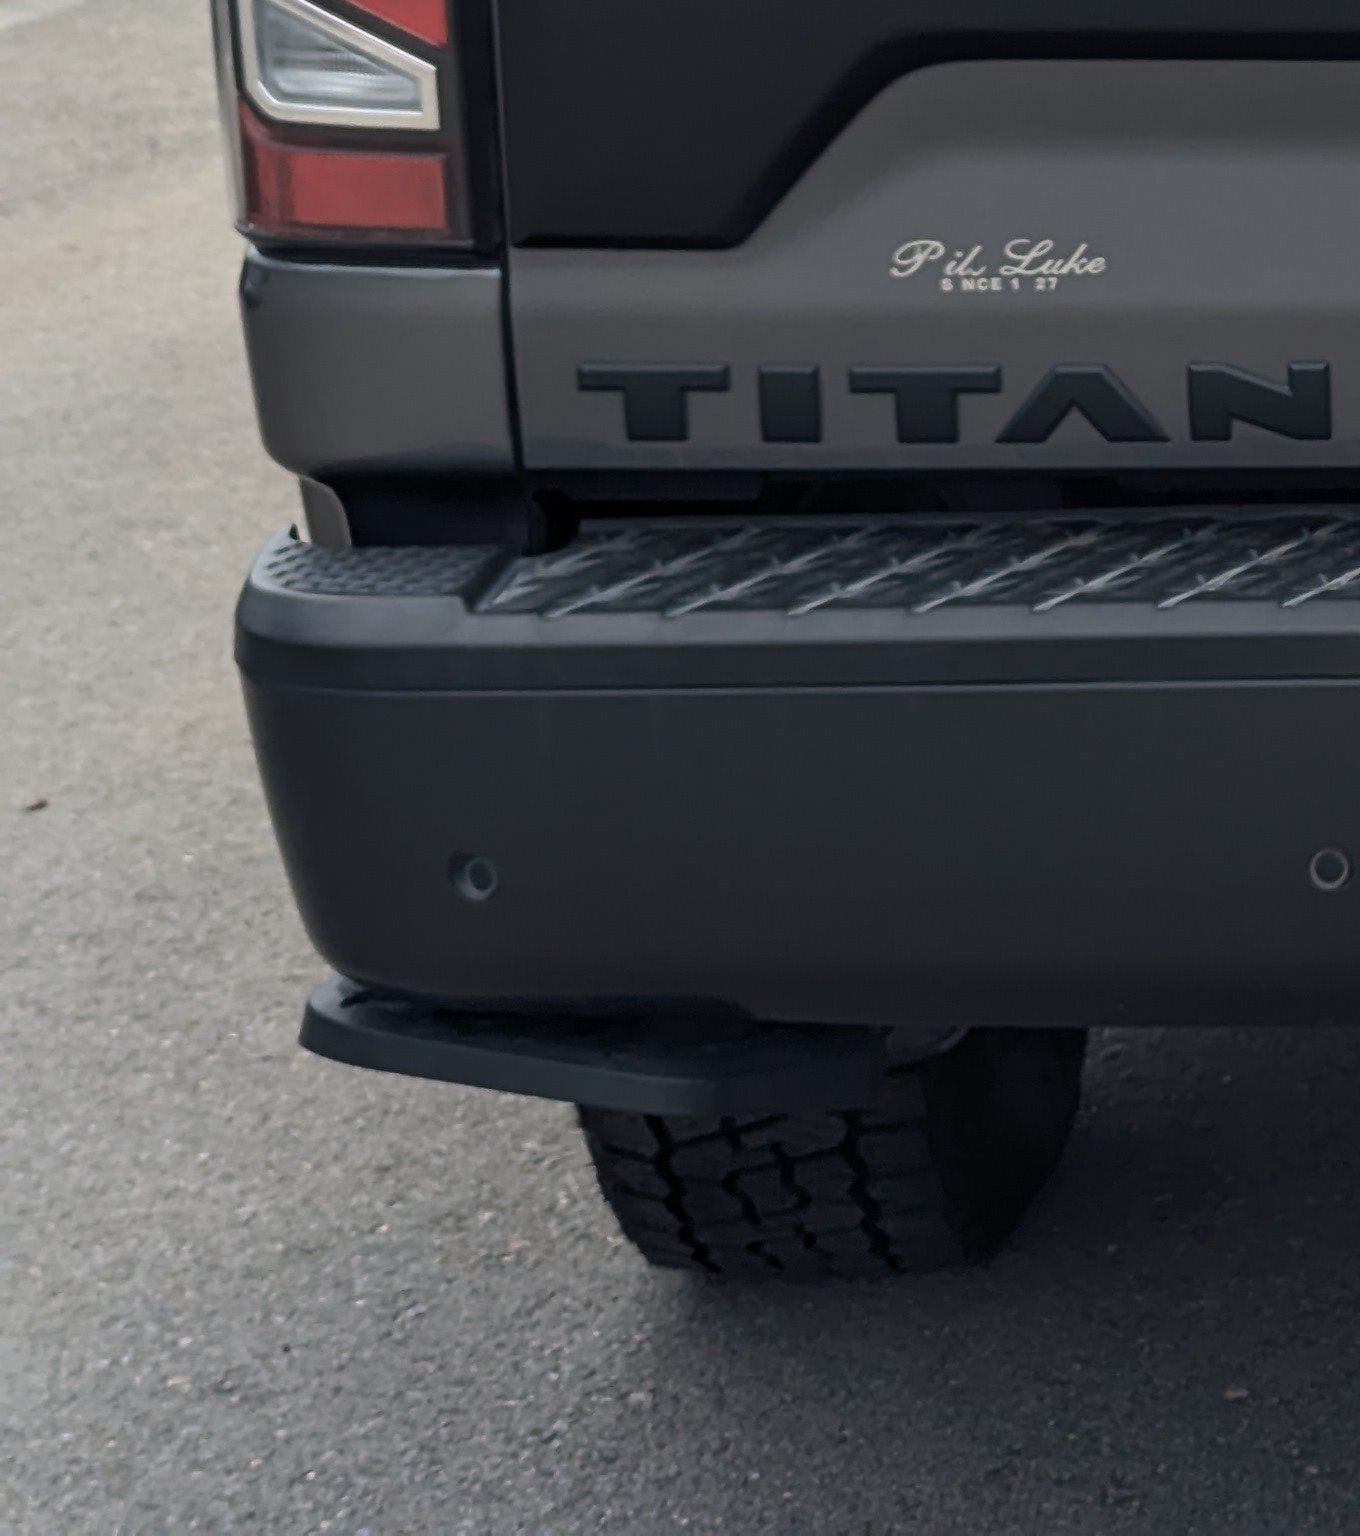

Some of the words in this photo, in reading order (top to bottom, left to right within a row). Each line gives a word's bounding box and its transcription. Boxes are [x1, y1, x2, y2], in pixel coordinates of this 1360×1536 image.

[999, 238, 1107, 276] Luke
[940, 277, 1003, 292] SNCE
[577, 361, 1332, 443] TITAN
